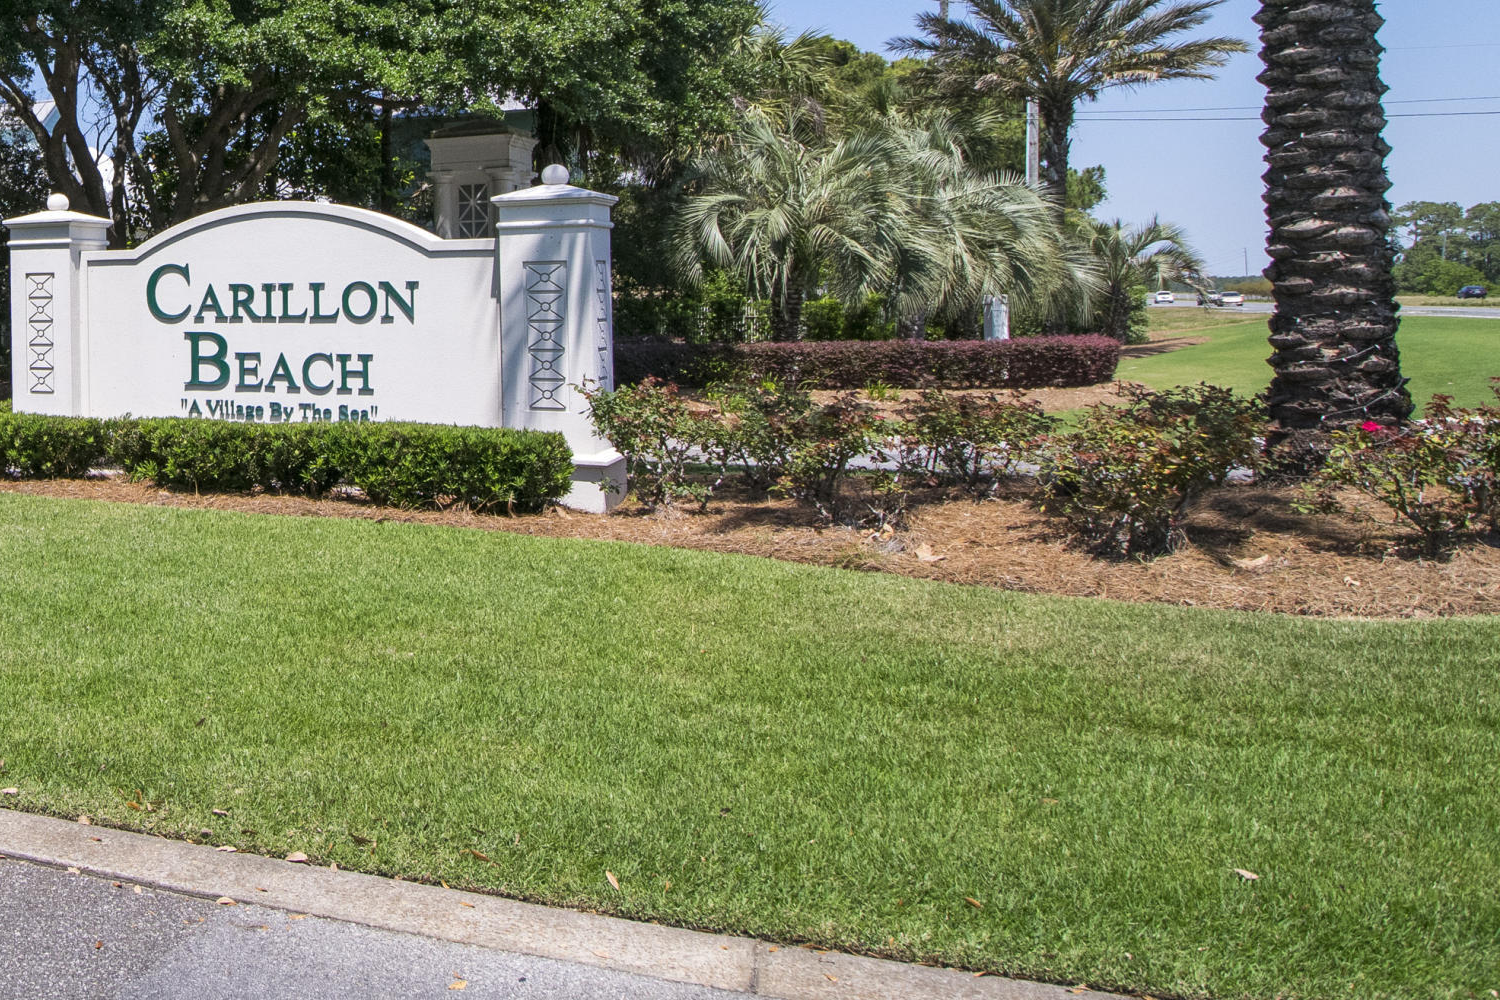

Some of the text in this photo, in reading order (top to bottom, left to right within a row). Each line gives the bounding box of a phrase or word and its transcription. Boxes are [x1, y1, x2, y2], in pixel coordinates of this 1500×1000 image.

[146, 262, 419, 325] CARILLON
[183, 331, 374, 395] BEACH
[205, 399, 264, 421] Village
[268, 401, 294, 422] By
[298, 403, 332, 422] The
